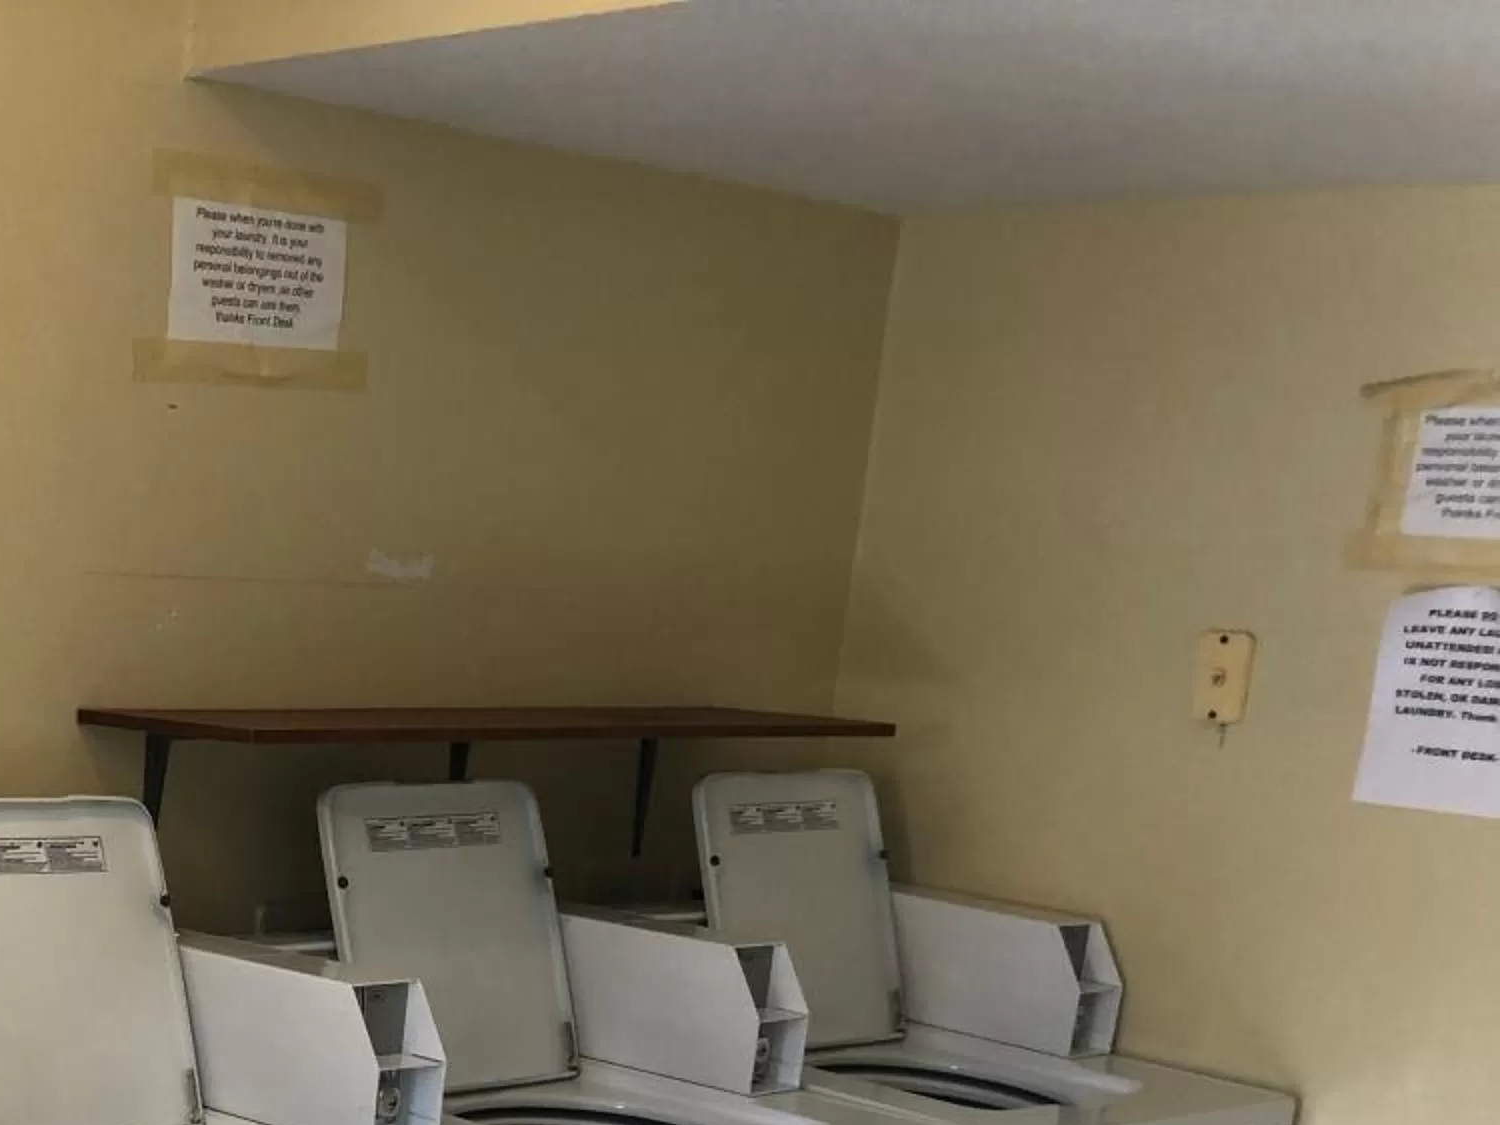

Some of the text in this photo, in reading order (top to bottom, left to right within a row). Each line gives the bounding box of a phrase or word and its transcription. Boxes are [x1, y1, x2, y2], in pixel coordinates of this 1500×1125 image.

[1428, 609, 1477, 619] PLEASE
[1403, 625, 1446, 634] LEAVE
[1449, 626, 1476, 636] ANY
[1419, 657, 1447, 667] NOT
[1419, 674, 1445, 684] FOR
[1447, 677, 1474, 686] ANY
